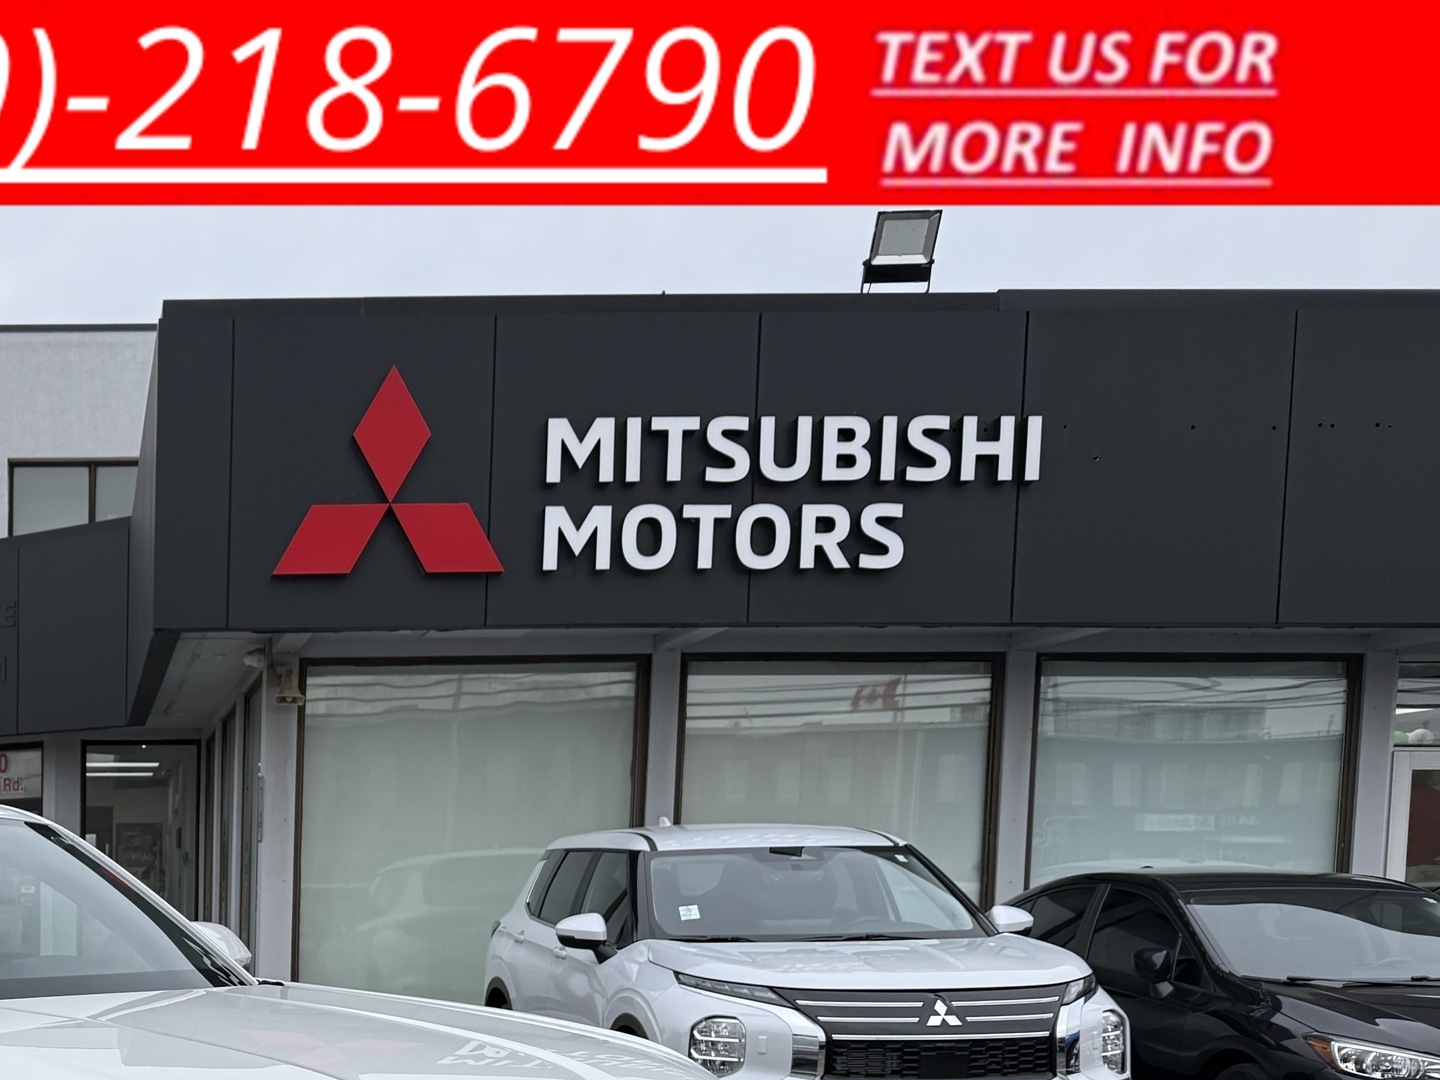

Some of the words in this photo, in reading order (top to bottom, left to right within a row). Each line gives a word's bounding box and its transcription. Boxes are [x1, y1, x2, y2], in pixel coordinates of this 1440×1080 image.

[545, 415, 1044, 484] MITSUBISHI
[541, 502, 906, 572] MOTORS
[3, 777, 24, 792] Rd.
